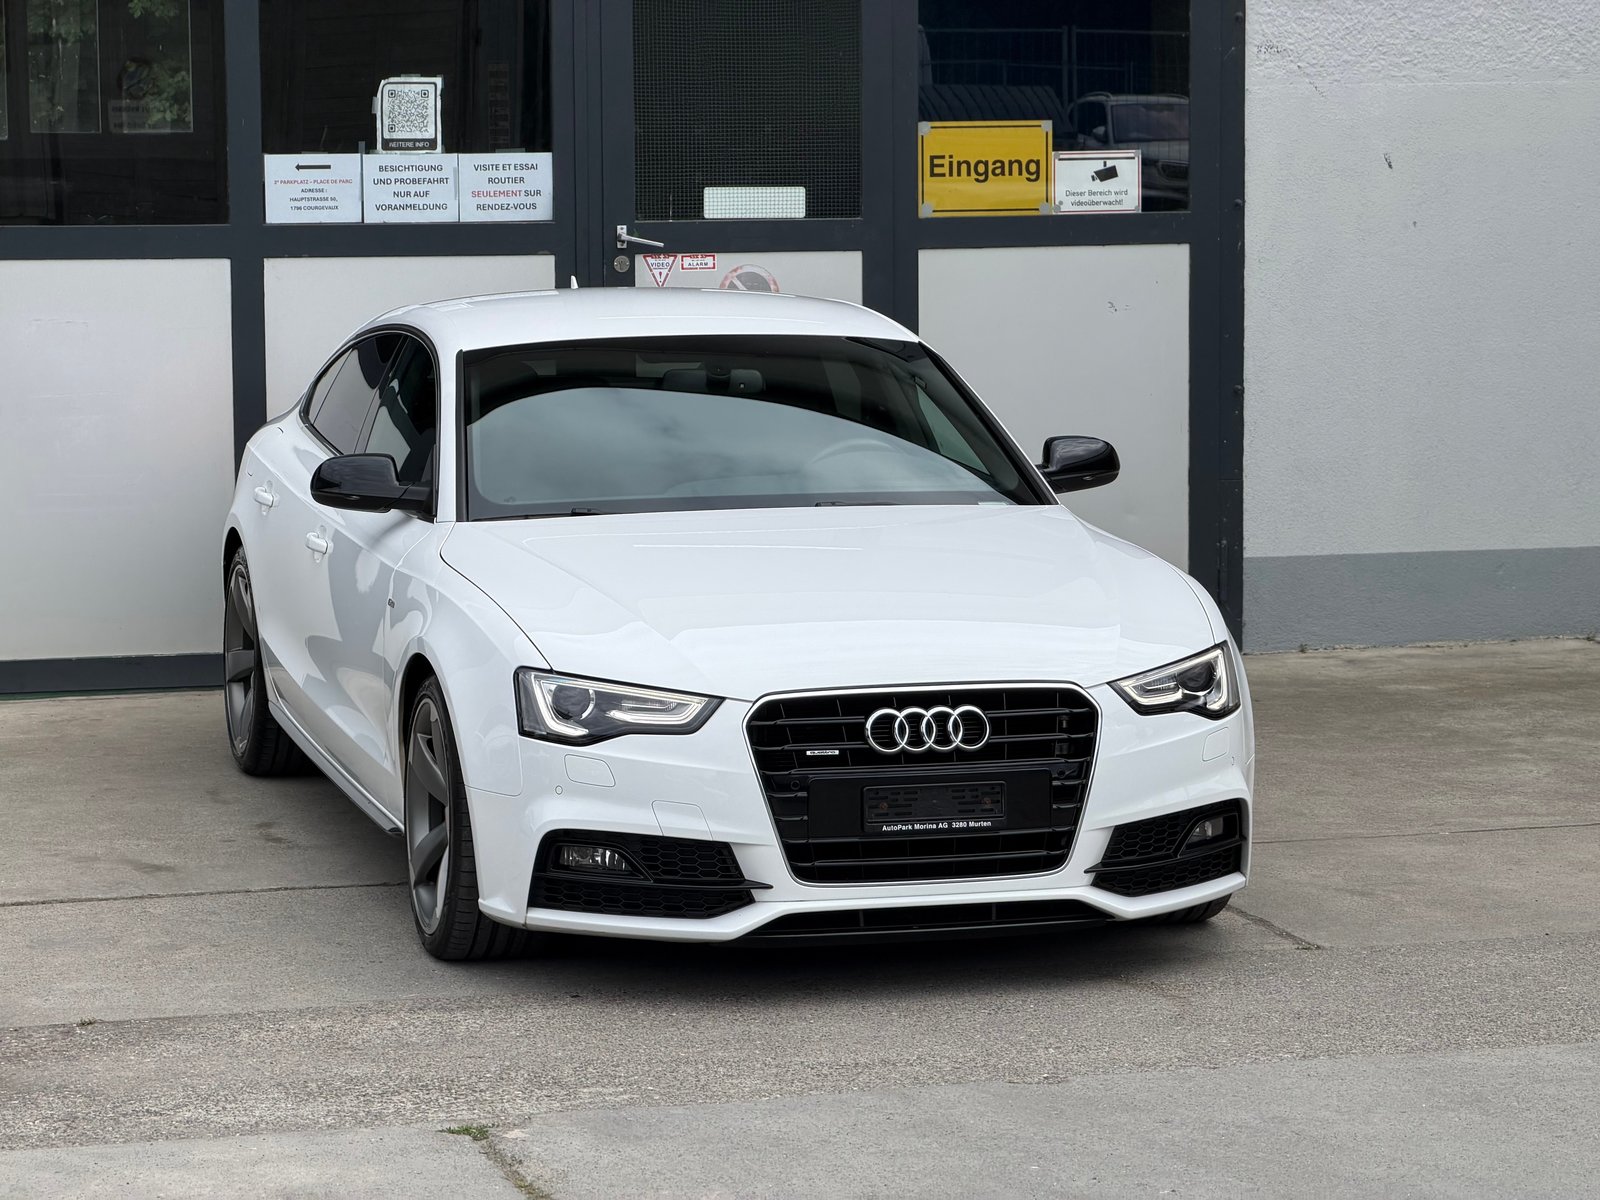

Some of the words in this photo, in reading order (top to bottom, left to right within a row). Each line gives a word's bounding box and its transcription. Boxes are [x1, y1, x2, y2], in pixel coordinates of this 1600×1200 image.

[378, 164, 443, 172] BESICHTIGUNG
[502, 163, 512, 171] ET
[929, 155, 1041, 183] Eingang
[394, 177, 449, 185] PROBEFAHRT
[471, 190, 523, 198] SEULEMENT
[524, 189, 542, 197] SUR
[375, 203, 448, 211] VORANMELDUNG
[476, 203, 537, 211] RENDEZ-VOUS
